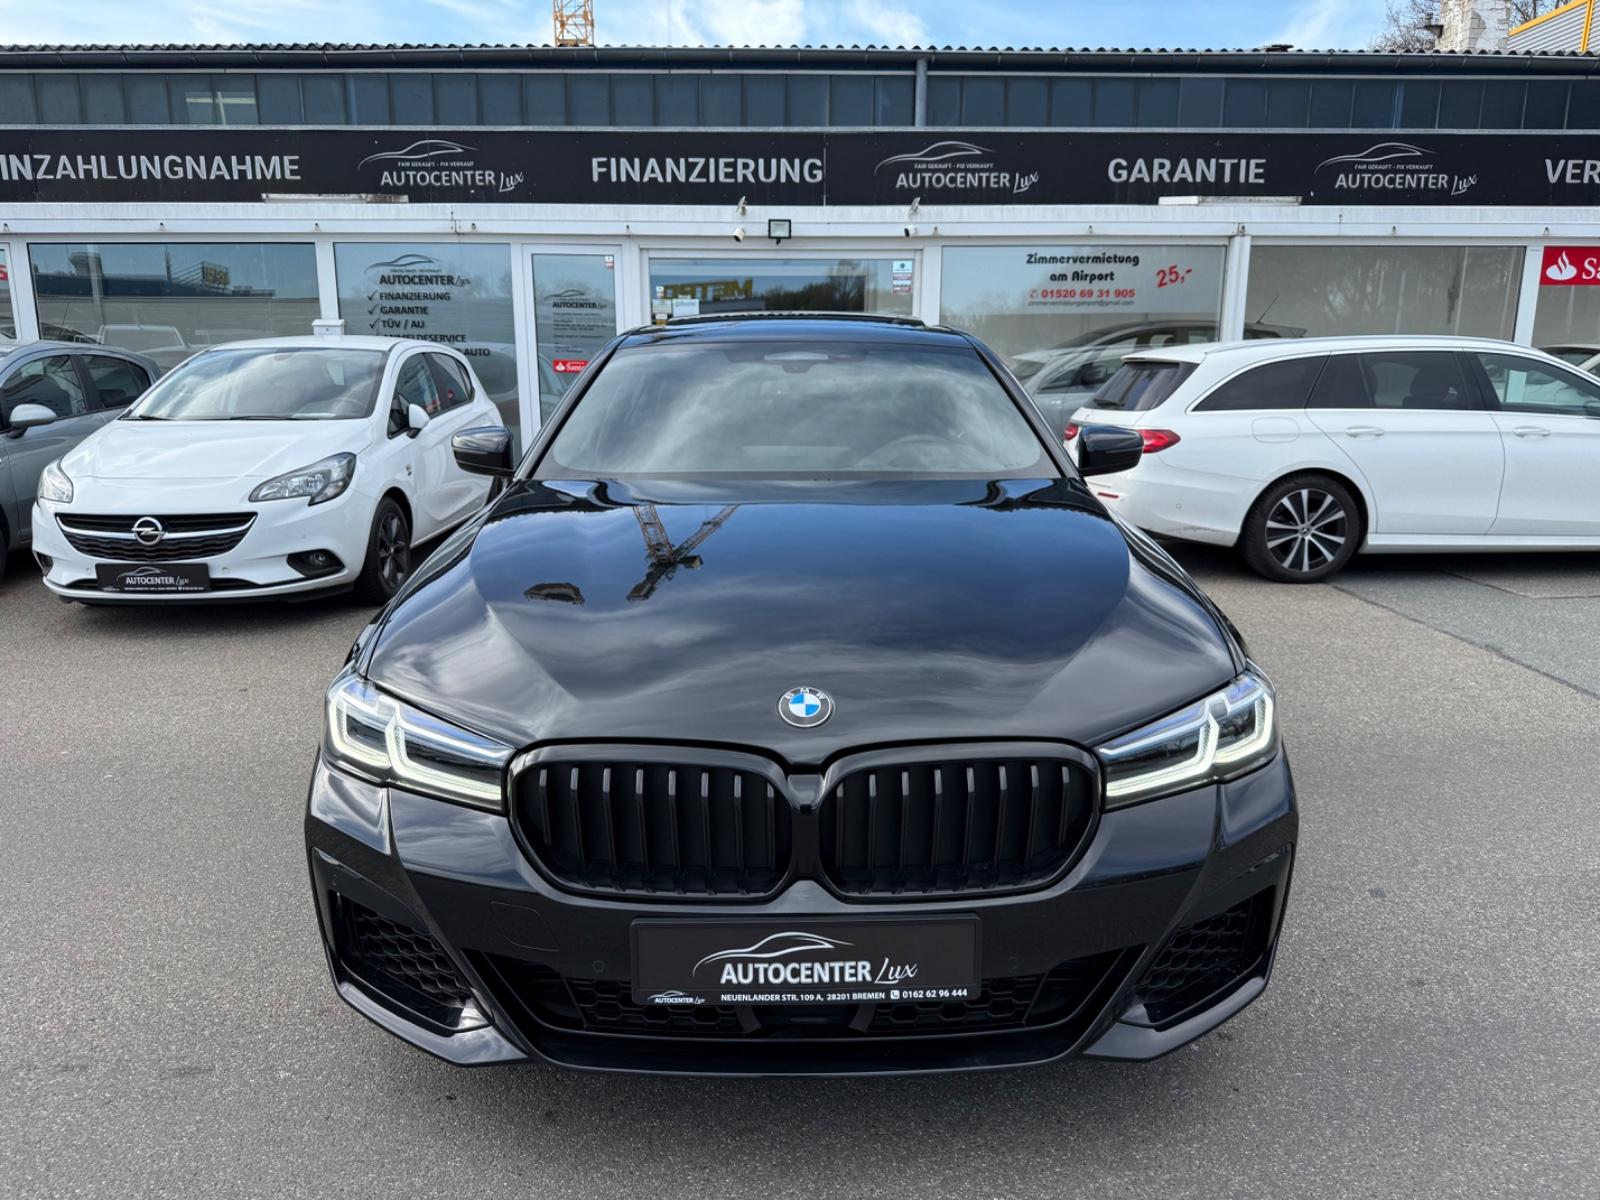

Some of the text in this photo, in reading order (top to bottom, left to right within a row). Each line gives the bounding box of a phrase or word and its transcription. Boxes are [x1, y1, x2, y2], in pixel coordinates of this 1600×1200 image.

[591, 157, 823, 184] FINANZIERUNG
[1107, 158, 1267, 184] GARANTIE
[1545, 159, 1600, 184] VER
[380, 170, 525, 193] AUTOCENTER Lux
[896, 171, 1039, 194] AUTOCENTER Lux
[1334, 173, 1478, 195] AUTOCENTER Lux
[1026, 253, 1140, 267] Zimmervermietung
[1582, 257, 1600, 280] S
[379, 275, 454, 285] AUTOCENTER
[1050, 270, 1114, 284] am Airport
[379, 292, 451, 301] FINANZIERUNG
[1041, 289, 1135, 298] 01520 69 31 905
[380, 306, 429, 315] GARANTIE
[552, 301, 596, 309] AUTOCENTER
[381, 318, 401, 328] TÜV
[410, 320, 425, 328] AU
[125, 576, 175, 585] AUTOCENTER
[720, 957, 918, 985] AUTOCENTER Lux
[827, 993, 850, 1001] 28201
[852, 991, 885, 1000] BREMEN
[902, 990, 923, 998] 0162
[951, 989, 967, 997] 444
